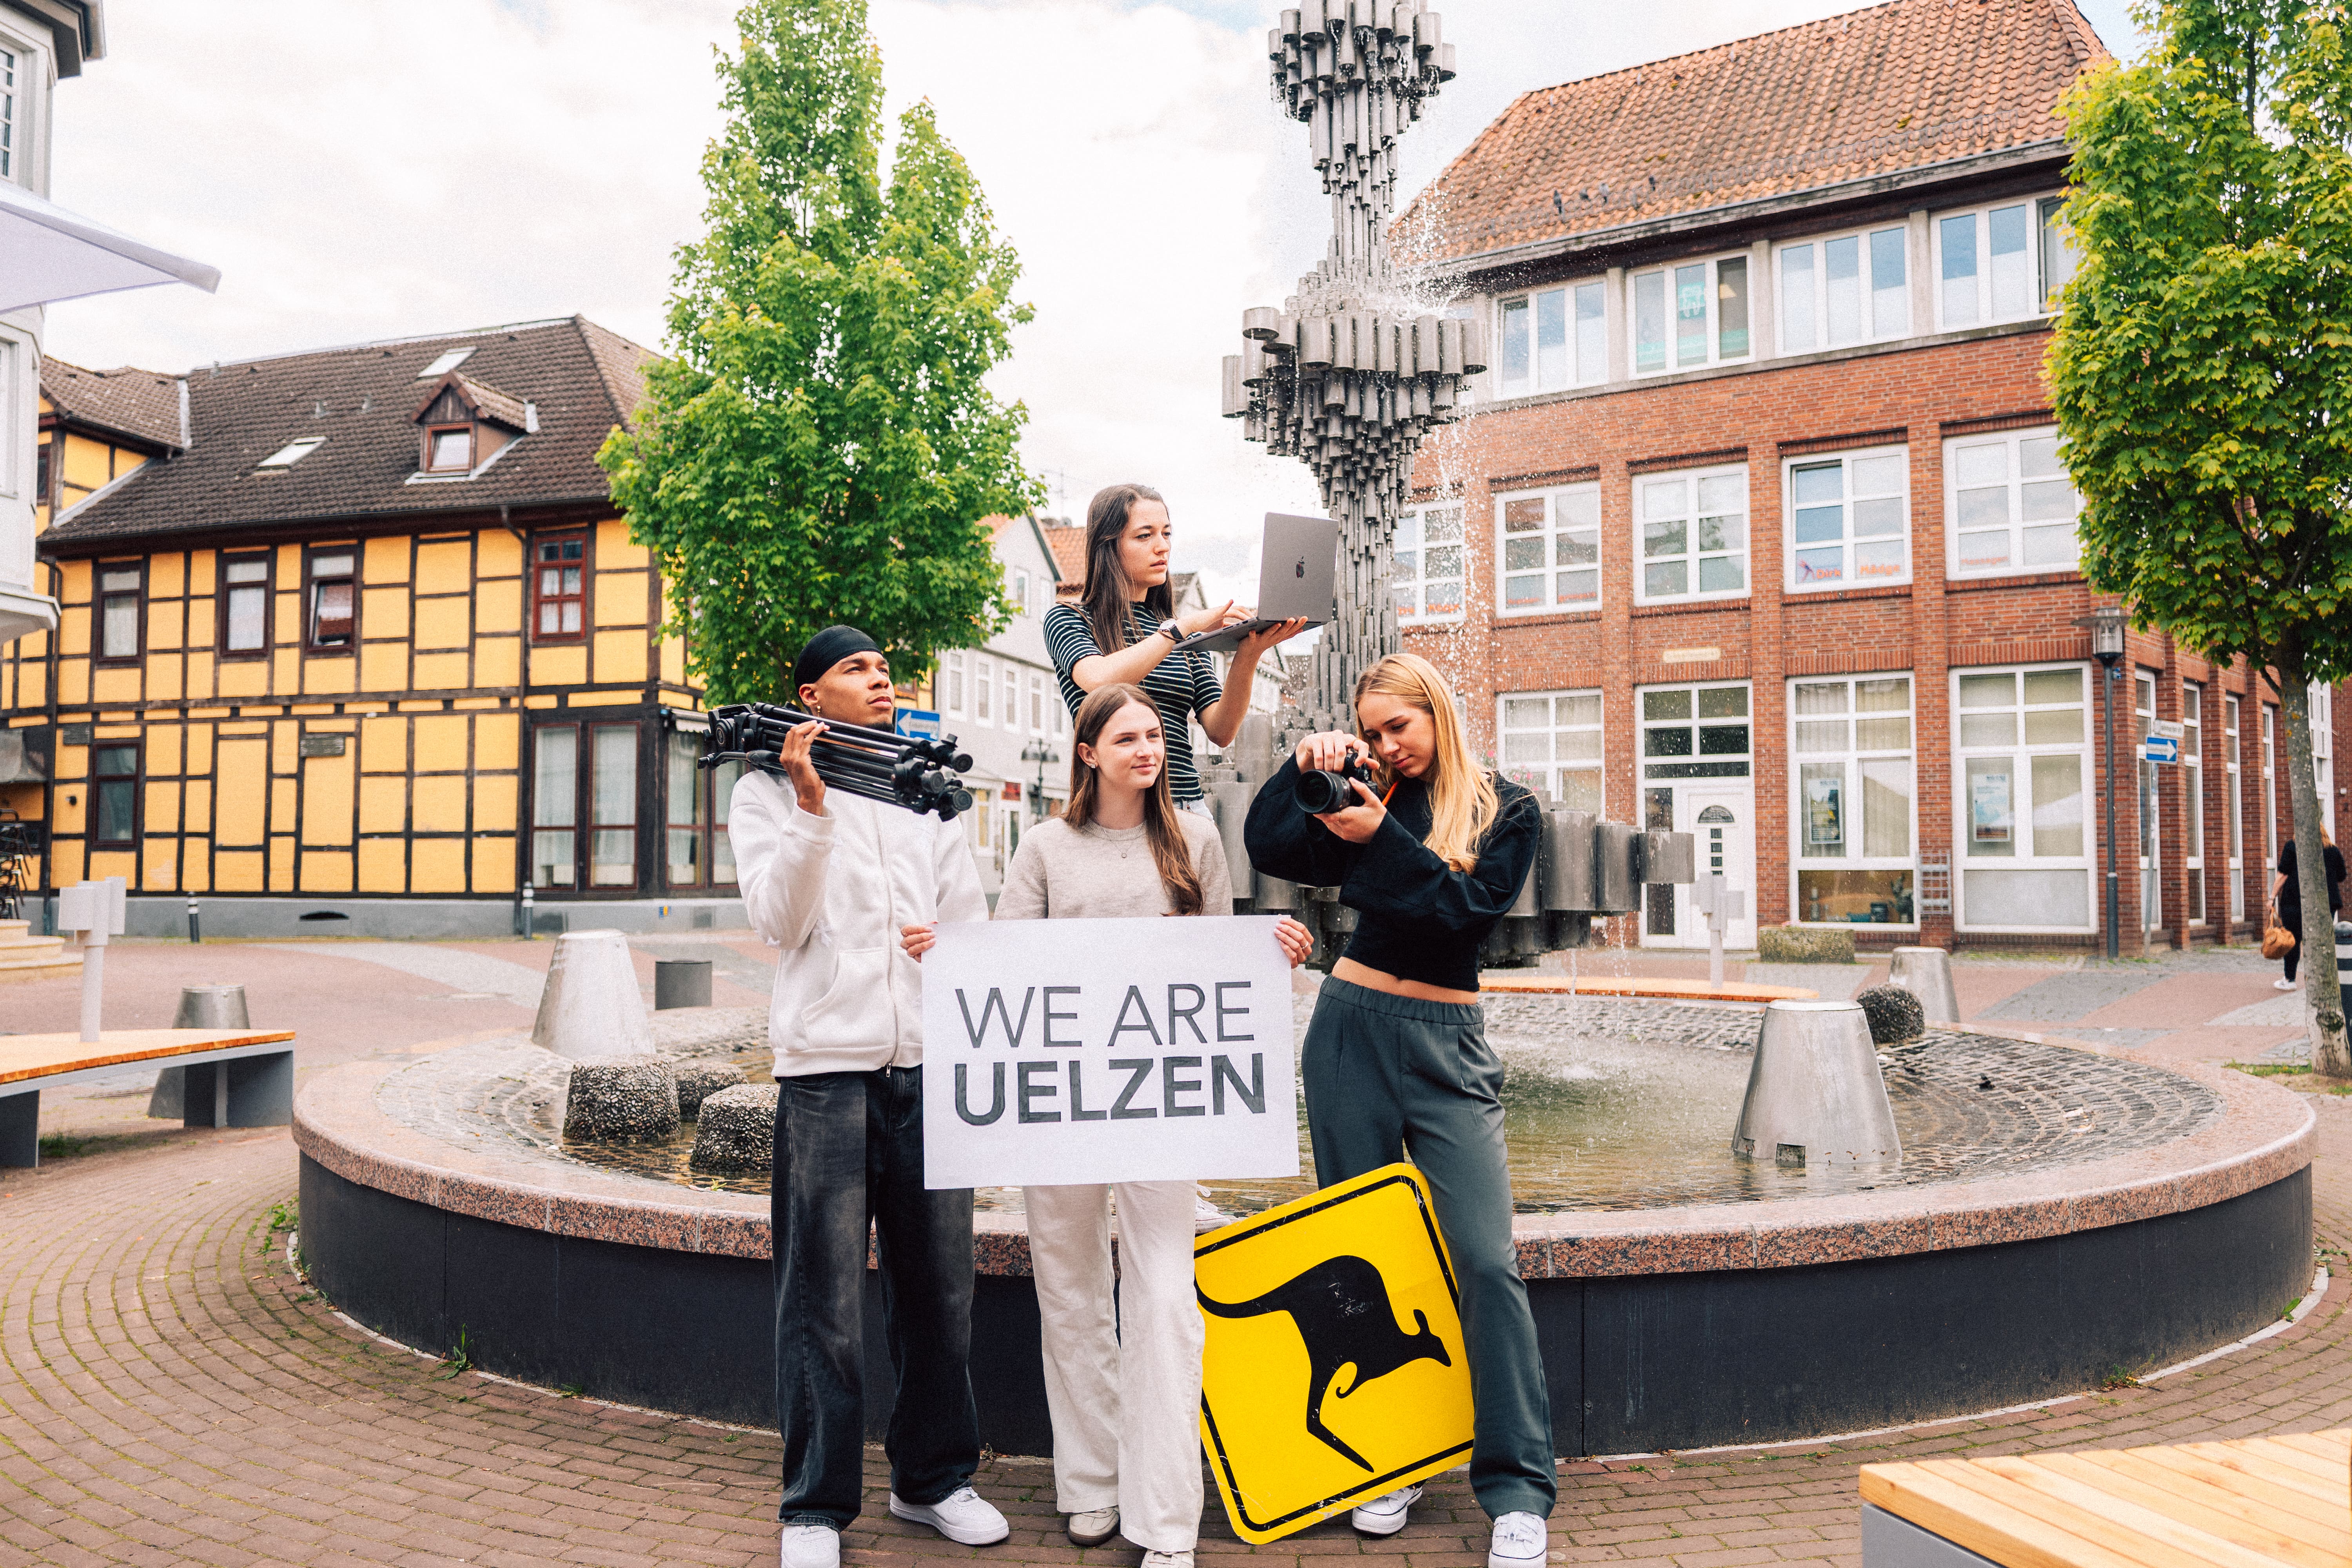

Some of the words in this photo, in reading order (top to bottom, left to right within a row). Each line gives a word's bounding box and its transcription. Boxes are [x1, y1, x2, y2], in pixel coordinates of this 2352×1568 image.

[1816, 568, 1841, 579] Dirk
[955, 986, 1082, 1048] WE
[1107, 981, 1255, 1047] ARE
[955, 1053, 1266, 1126] UELZEN
